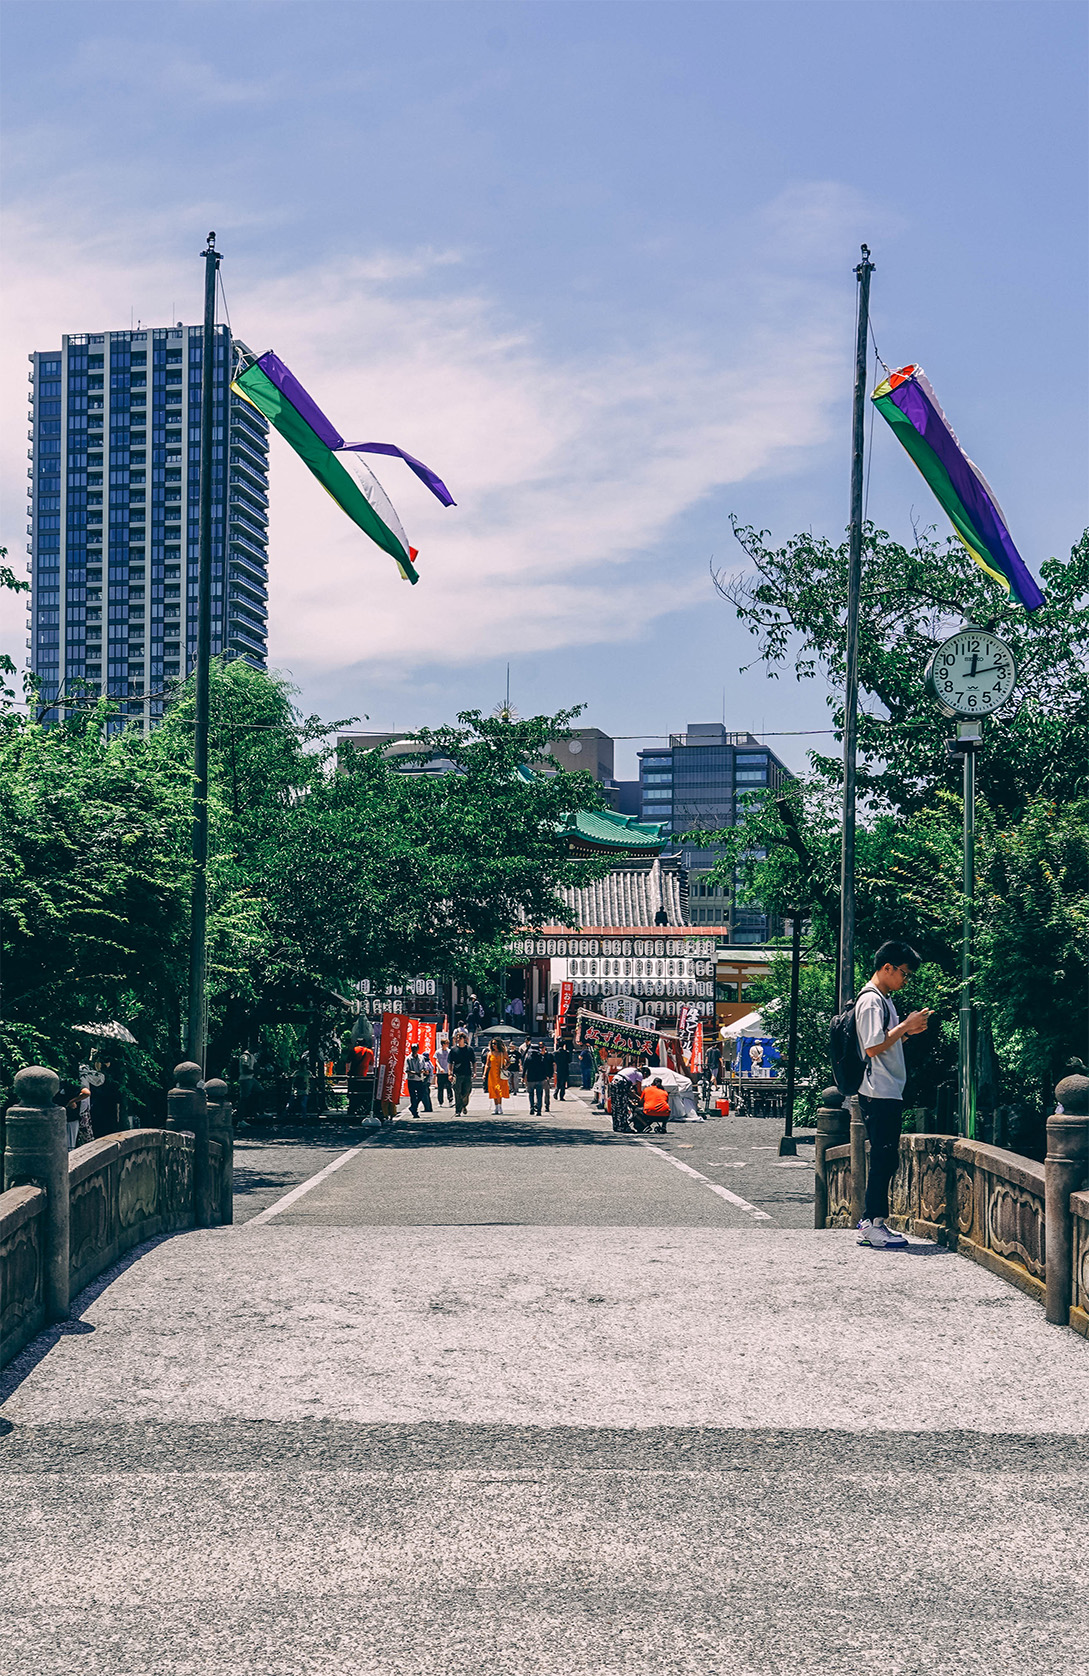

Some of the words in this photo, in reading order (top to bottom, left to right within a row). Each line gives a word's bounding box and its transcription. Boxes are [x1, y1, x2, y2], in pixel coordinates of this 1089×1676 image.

[955, 643, 965, 656] 11
[967, 640, 980, 653] 12
[943, 653, 955, 666] 10
[993, 653, 1002, 665] 2
[939, 667, 948, 680] 9
[996, 667, 1006, 679] 3
[944, 680, 953, 692] 8
[992, 681, 1002, 692] 4
[955, 692, 964, 703] 7
[968, 695, 977, 707] 6
[982, 691, 991, 703] 5
